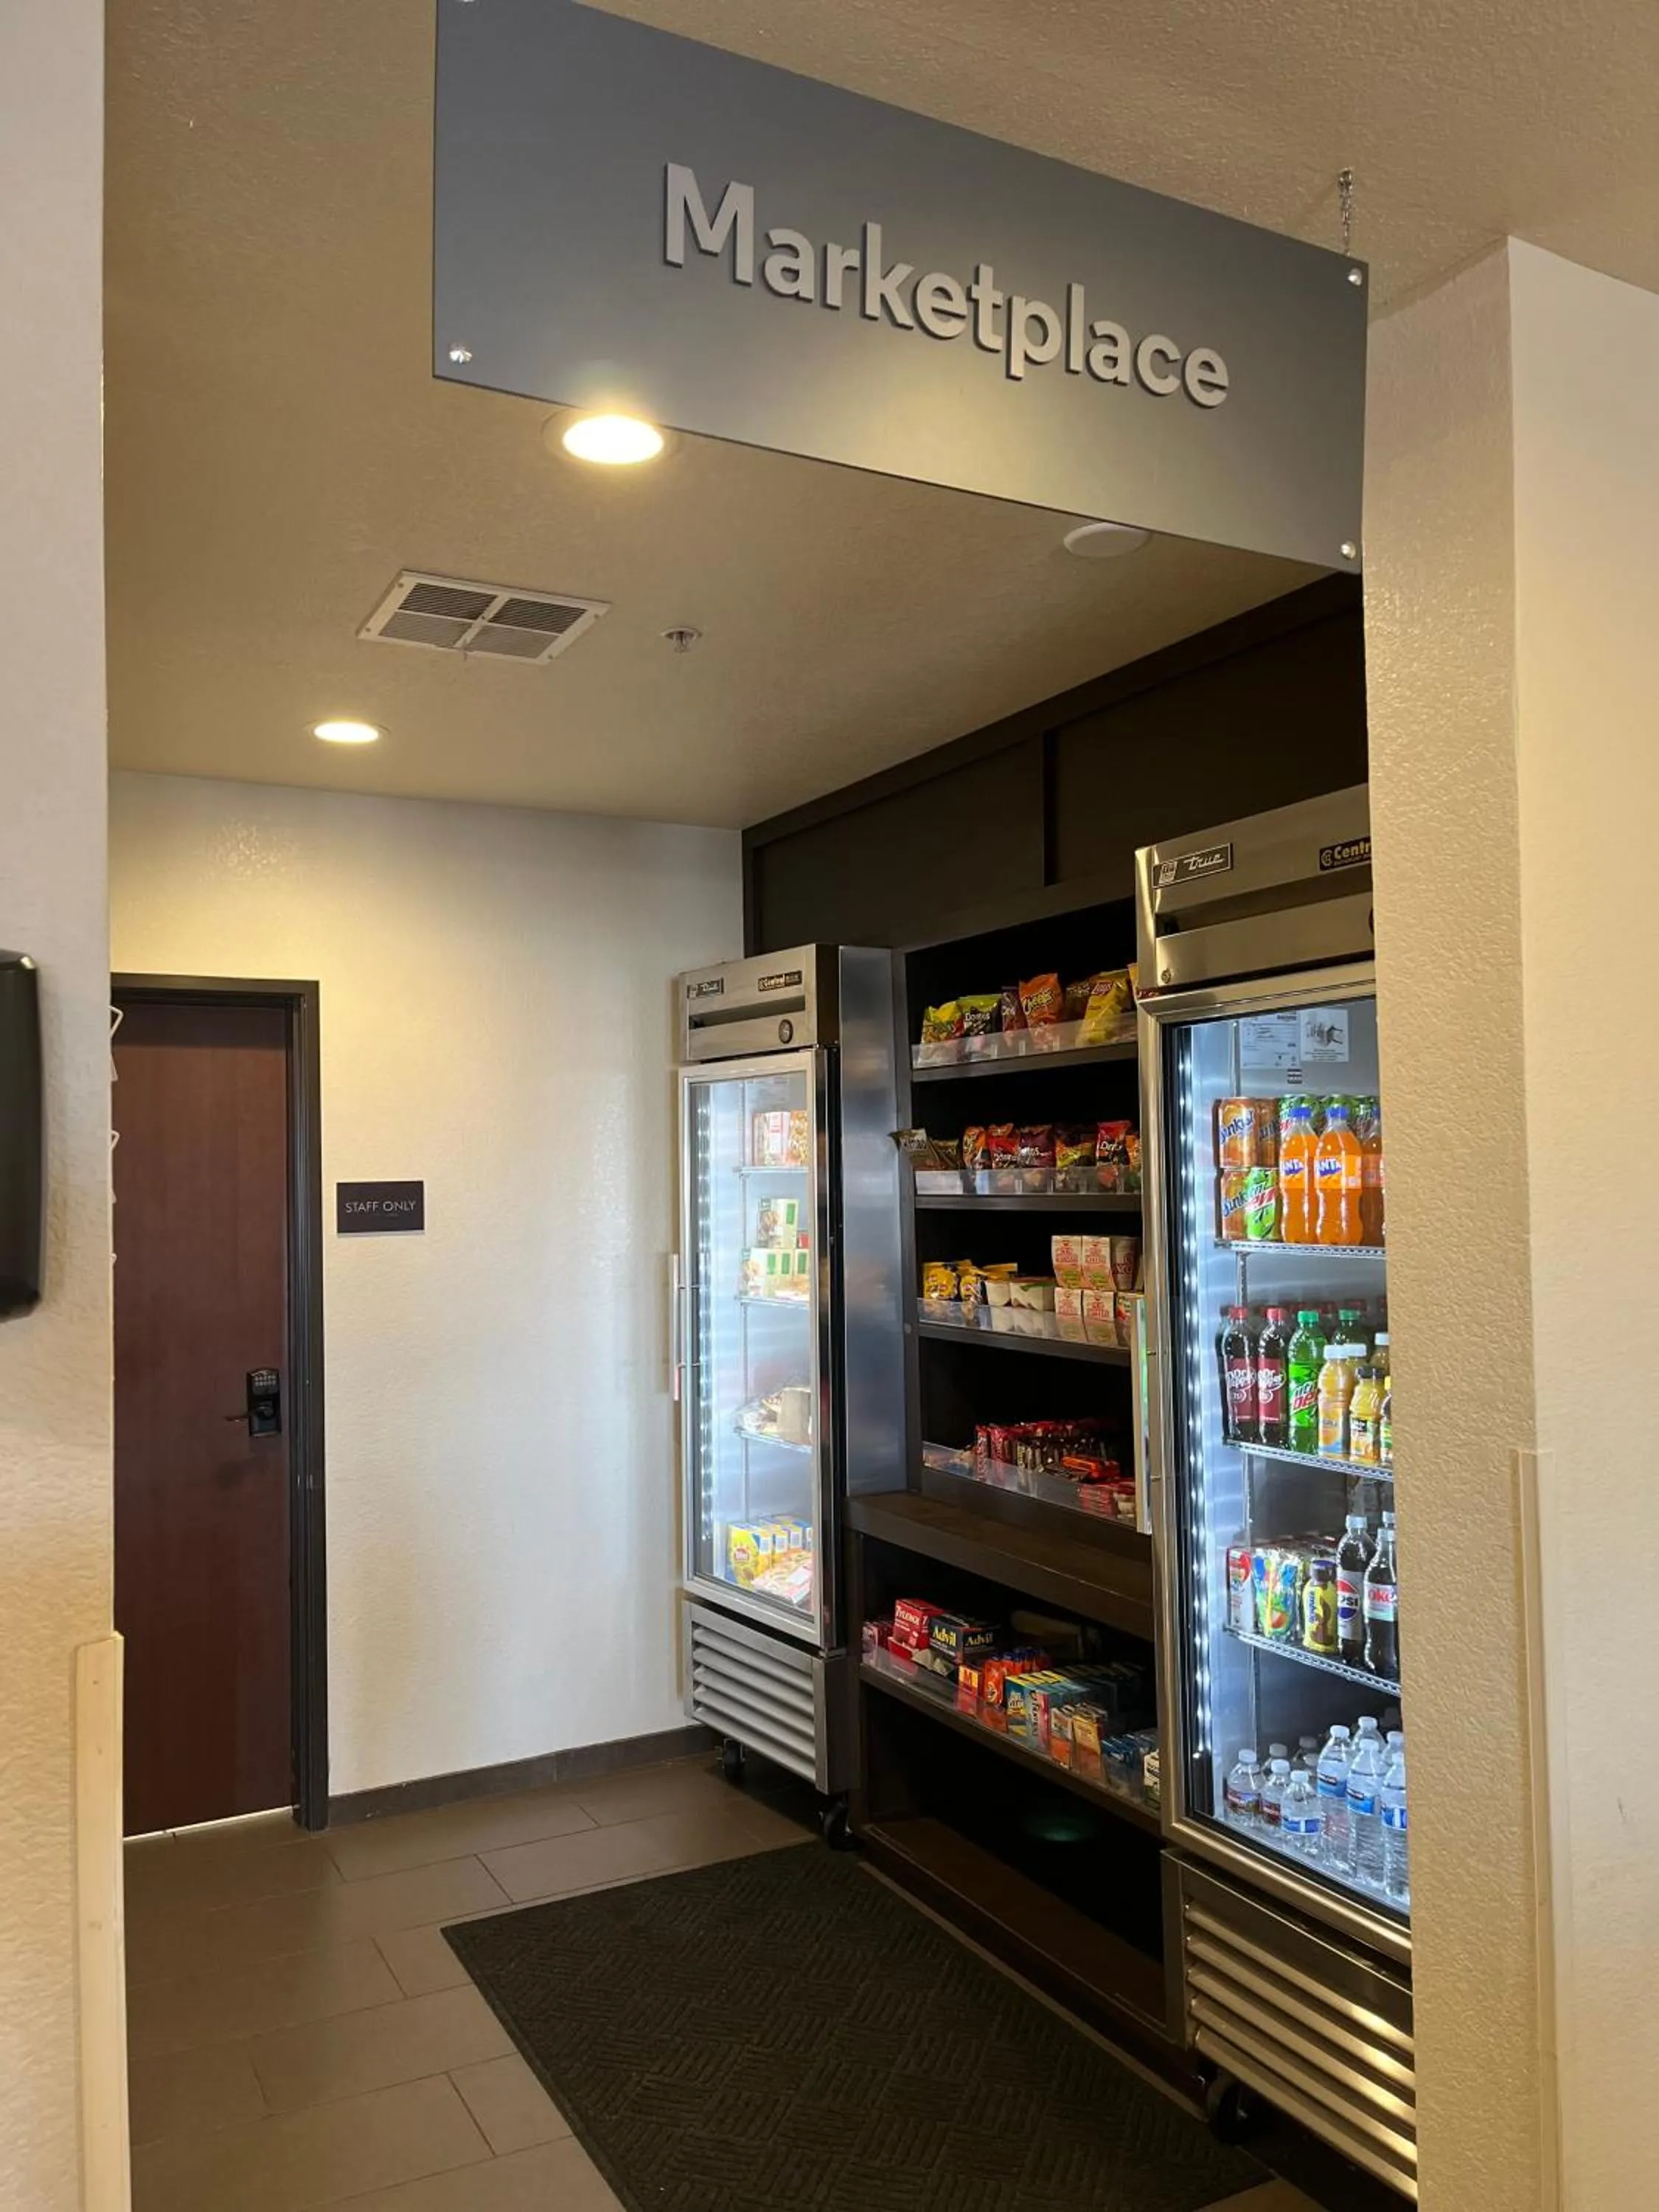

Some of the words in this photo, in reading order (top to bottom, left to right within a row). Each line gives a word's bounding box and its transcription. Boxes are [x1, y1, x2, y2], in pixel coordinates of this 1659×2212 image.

[663, 161, 1229, 408] Marketplace
[1183, 854, 1225, 870] True
[1022, 989, 1054, 1015] Cheetos
[965, 1012, 990, 1022] Doritos
[344, 1201, 380, 1214] STAFF
[383, 1200, 417, 1212] ONLY
[932, 1624, 956, 1646] Advil
[964, 1631, 993, 1646] Advil
